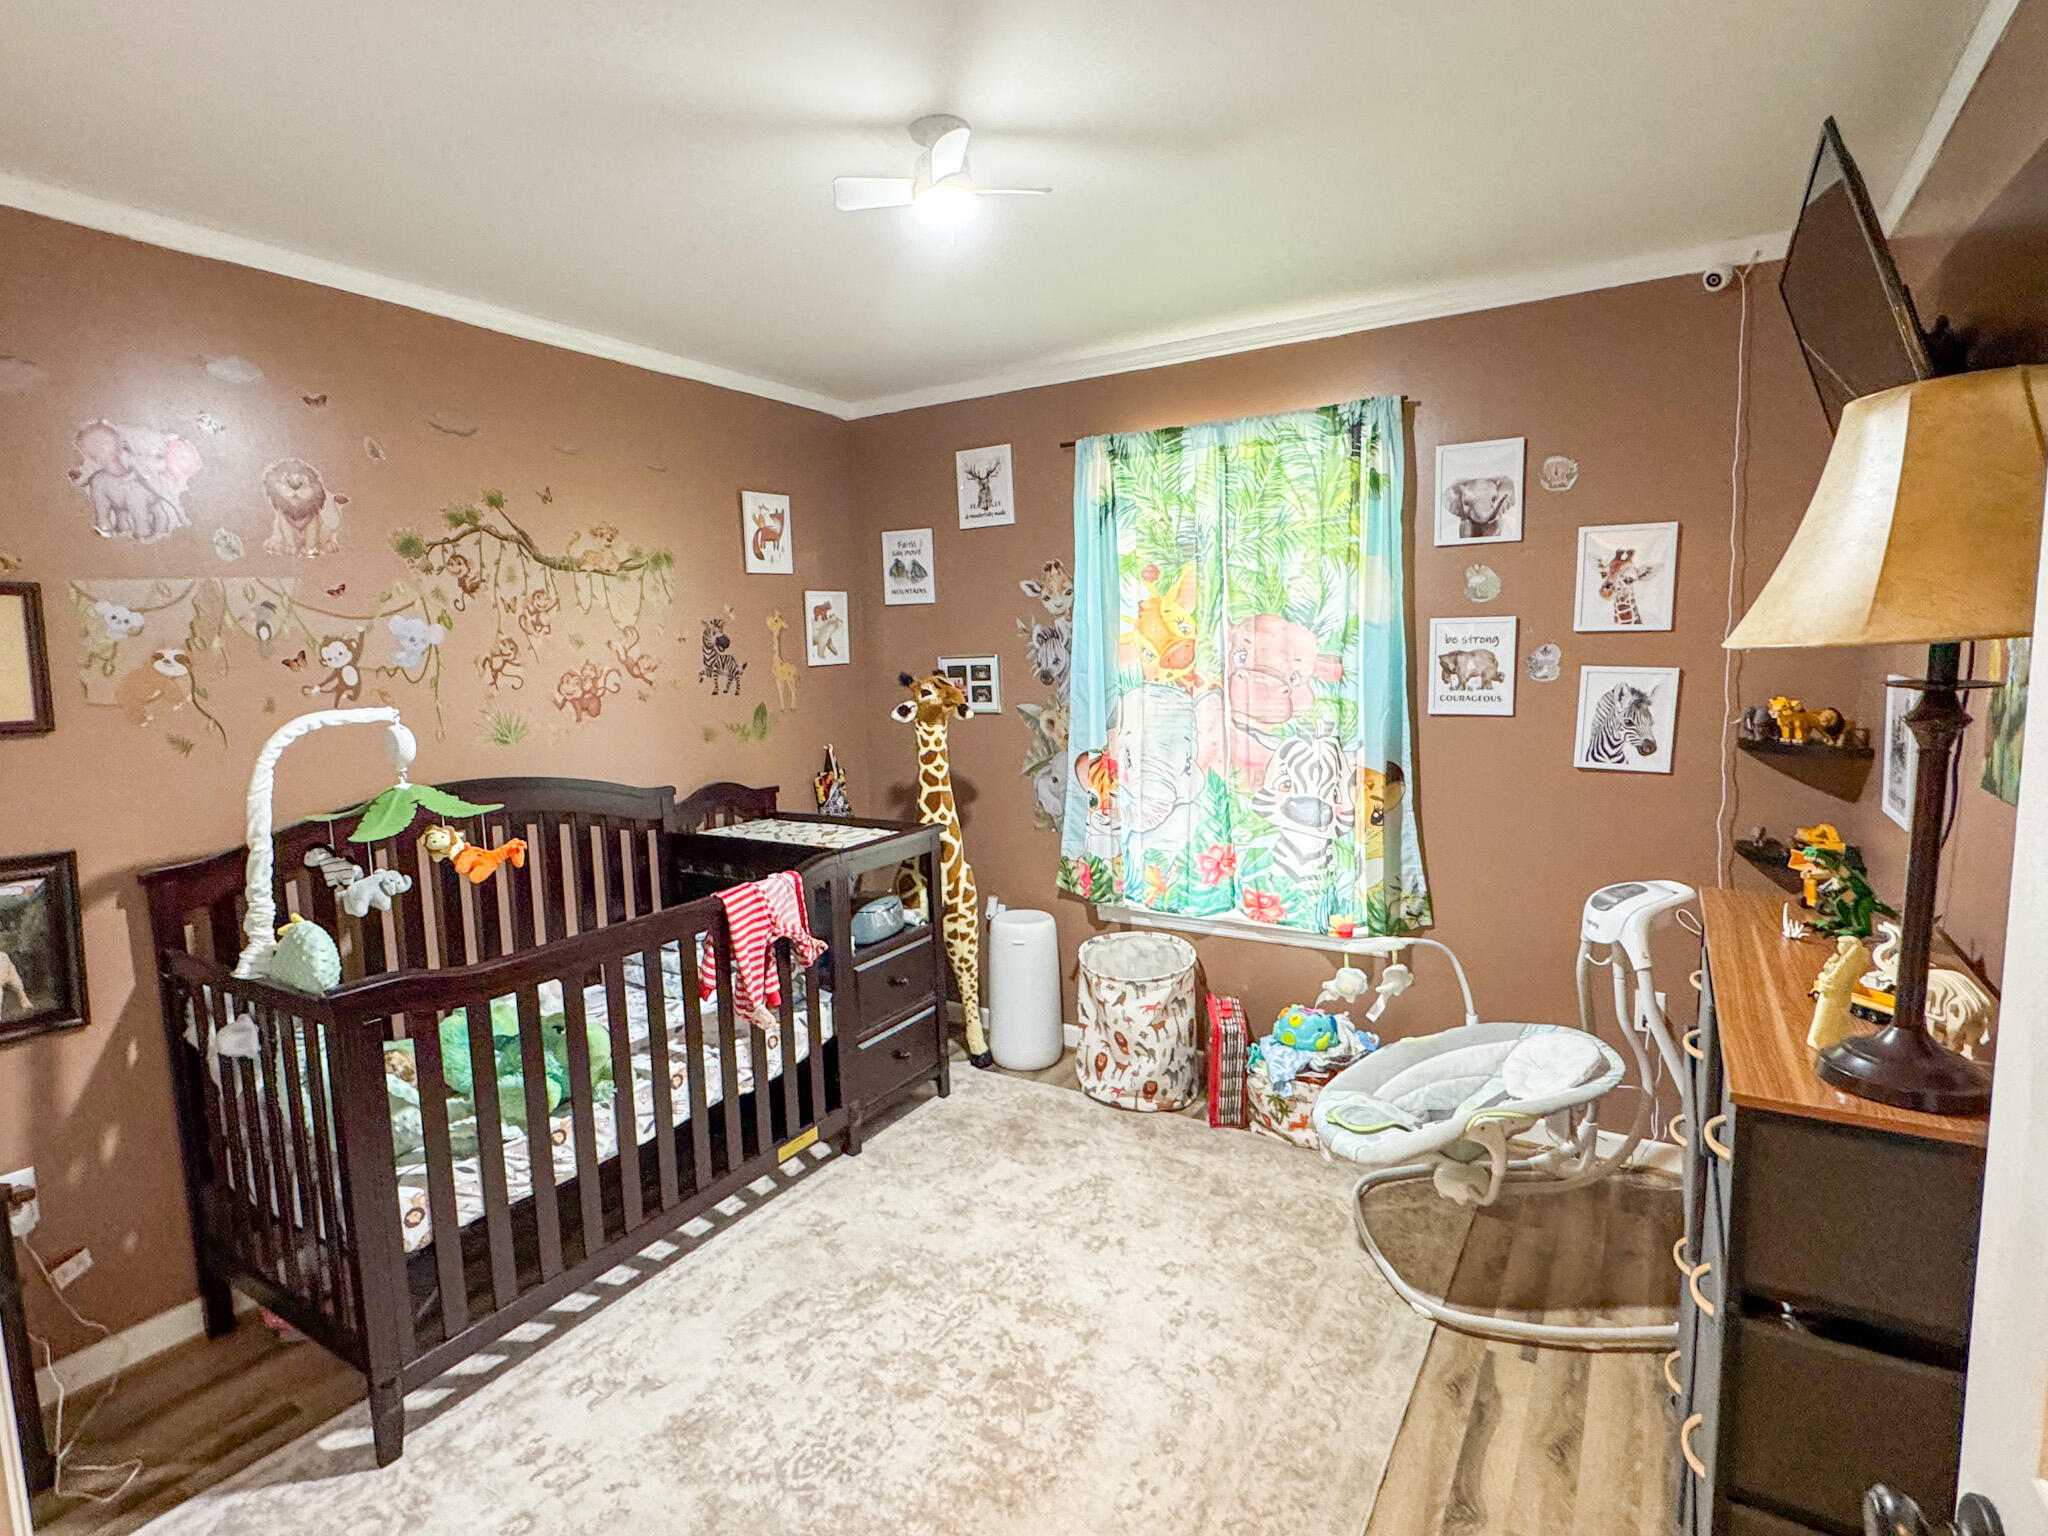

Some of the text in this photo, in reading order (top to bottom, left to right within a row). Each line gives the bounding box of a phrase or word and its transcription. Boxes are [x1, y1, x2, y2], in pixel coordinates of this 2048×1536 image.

[1445, 634, 1499, 647] be strong
[1439, 694, 1502, 702] COURAGEOUS
